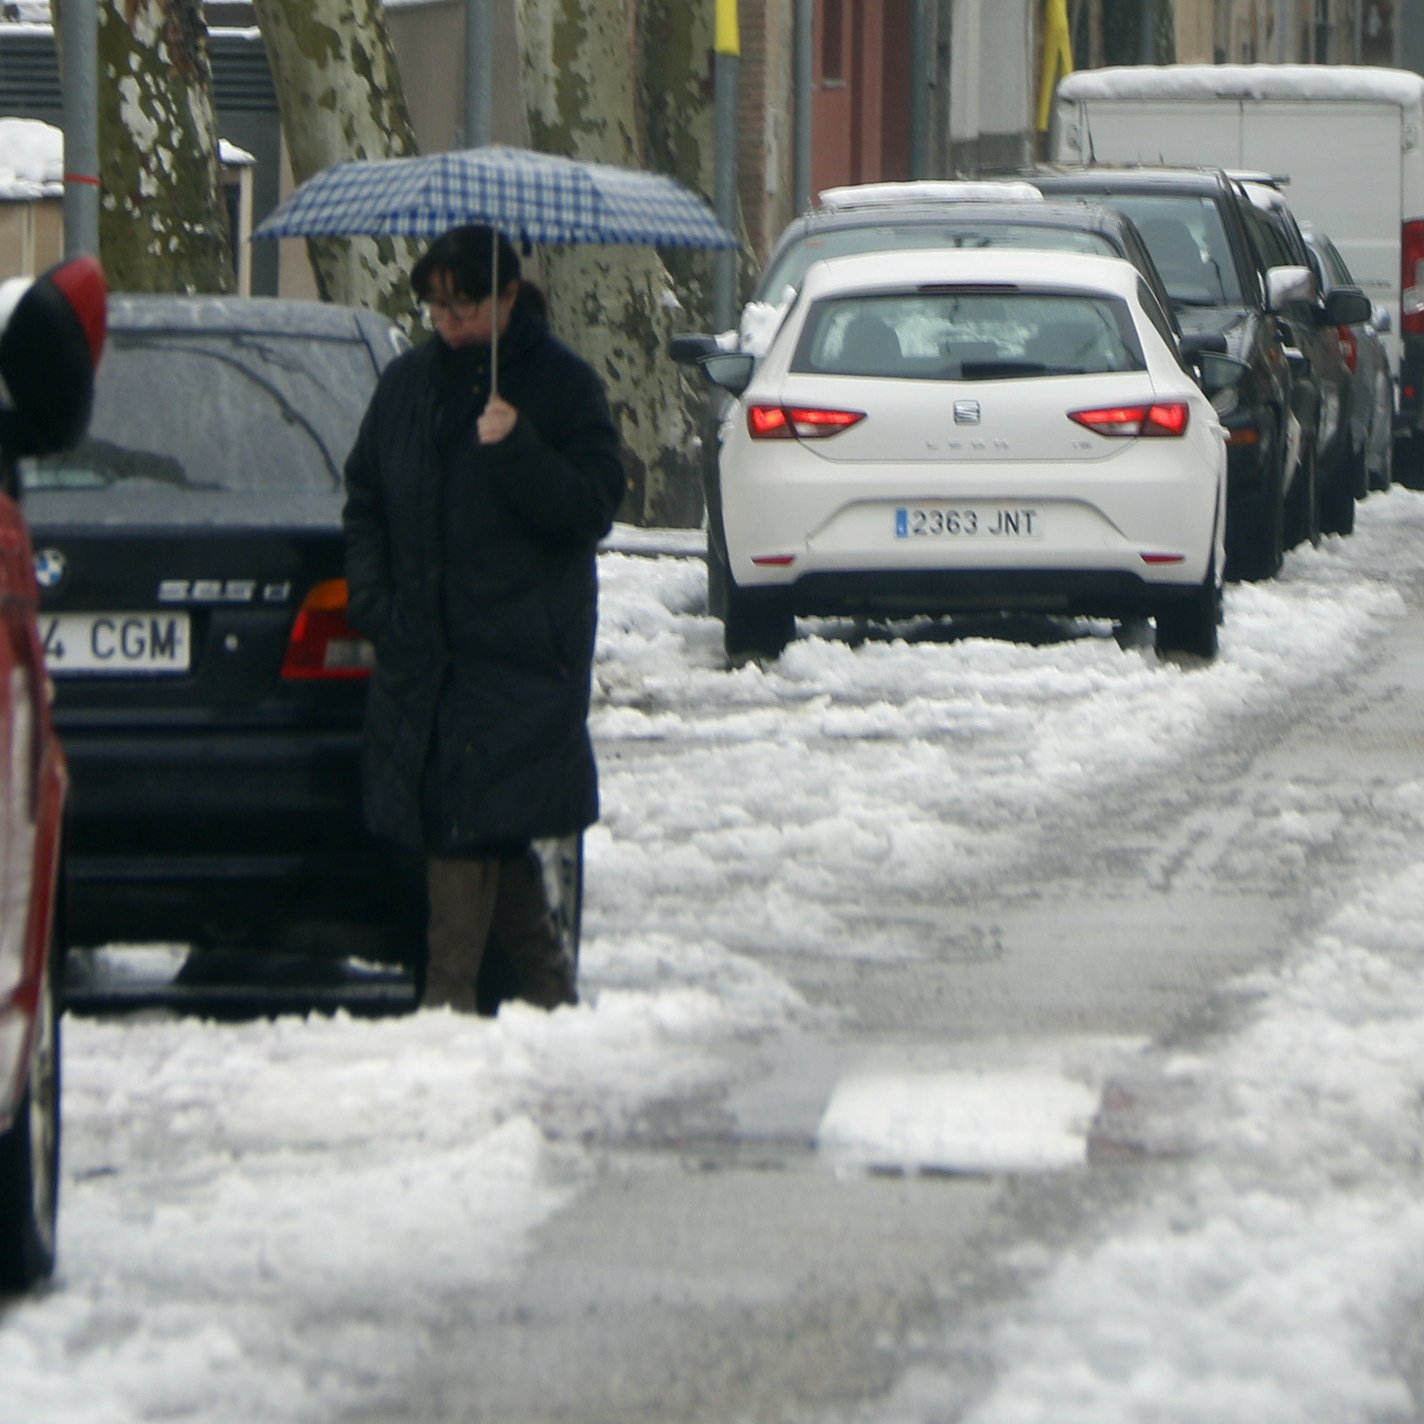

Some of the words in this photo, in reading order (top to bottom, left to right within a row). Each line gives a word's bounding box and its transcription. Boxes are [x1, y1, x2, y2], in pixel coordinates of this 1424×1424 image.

[912, 509, 978, 536] 2363
[988, 509, 1038, 536] JNT
[90, 617, 178, 660] CGM
